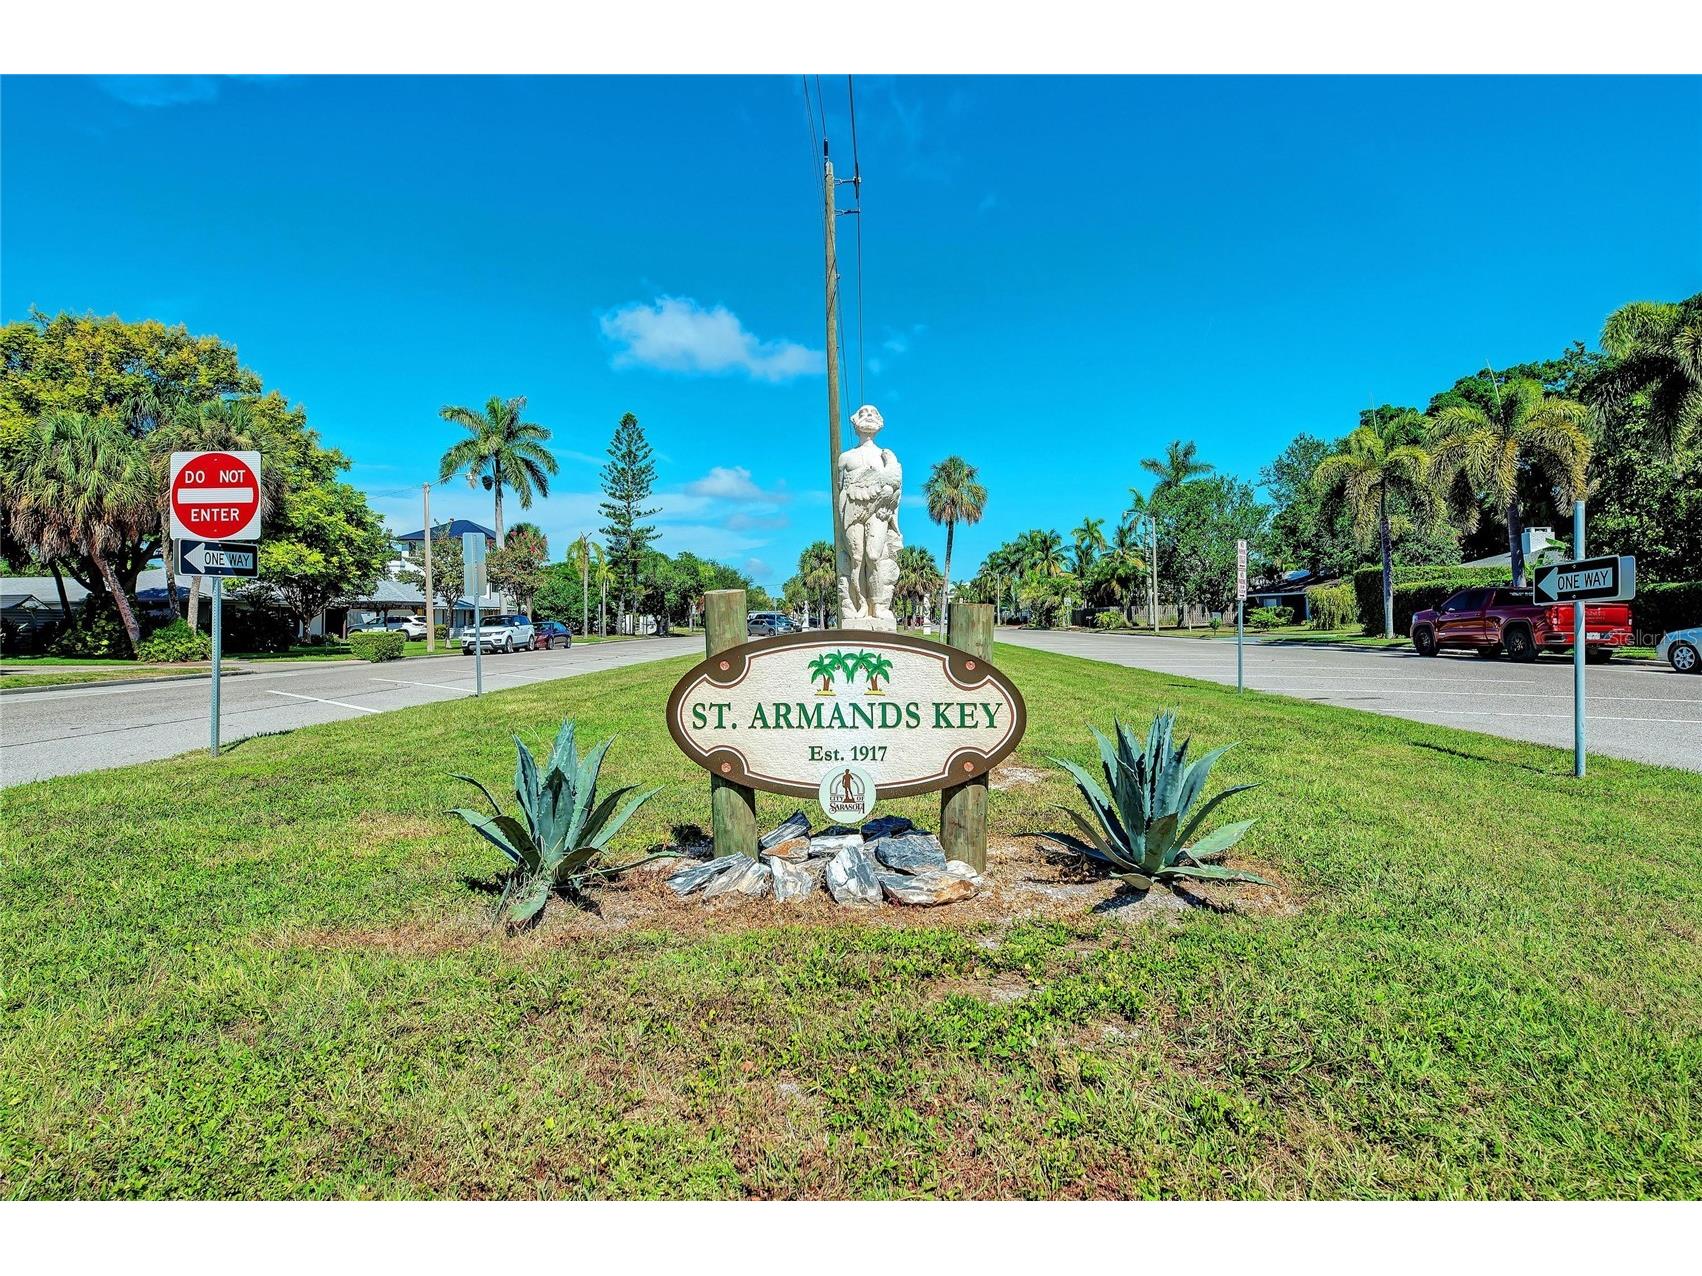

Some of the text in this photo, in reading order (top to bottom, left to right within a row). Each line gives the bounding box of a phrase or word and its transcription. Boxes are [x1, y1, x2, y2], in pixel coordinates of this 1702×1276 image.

[184, 469, 246, 484] DO NOT
[190, 508, 240, 522] ENTER
[204, 551, 250, 567] ONE WAY
[1557, 569, 1609, 591] ONE WAY
[692, 701, 1003, 730] ST. ARMANDS KEY
[808, 745, 888, 762] Est. 1917
